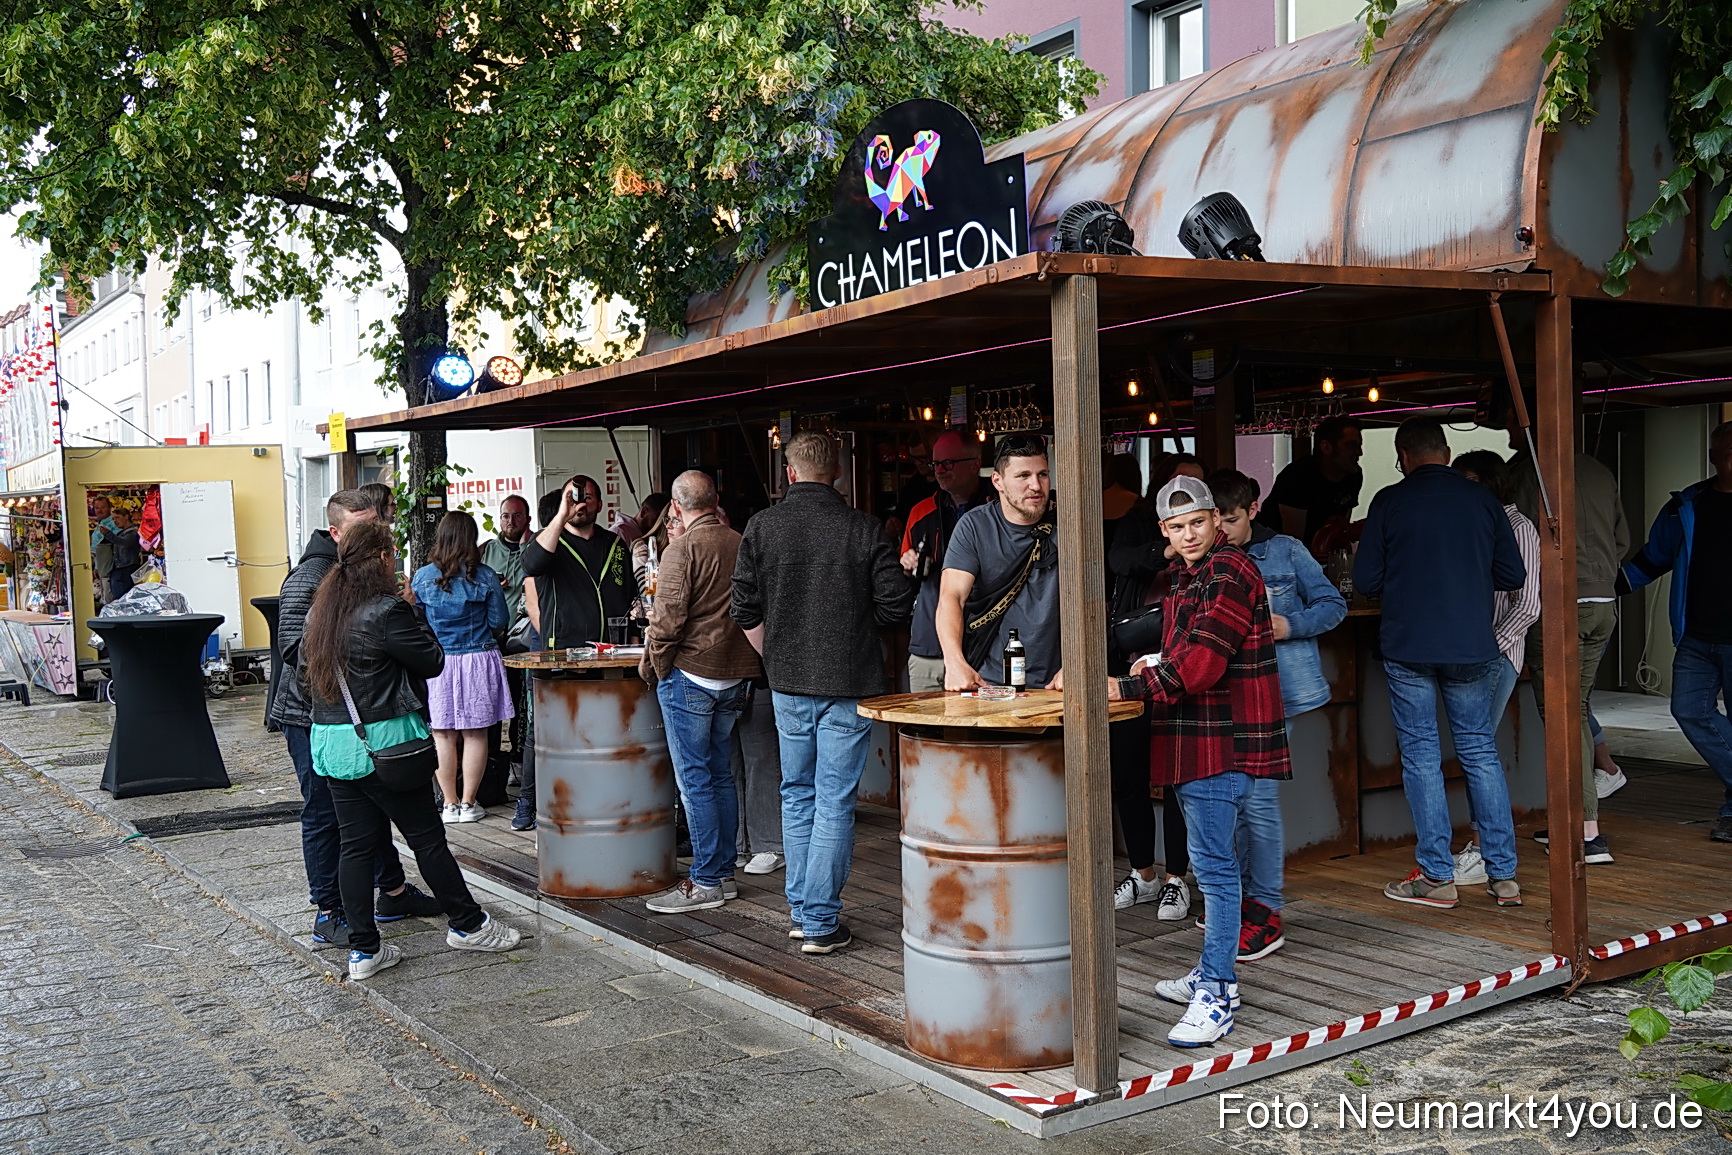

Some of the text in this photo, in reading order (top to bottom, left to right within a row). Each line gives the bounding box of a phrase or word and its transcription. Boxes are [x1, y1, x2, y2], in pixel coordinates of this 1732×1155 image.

[817, 207, 1018, 308] CHAMELEON
[425, 512, 436, 523] 39
[605, 459, 621, 529] RLEIN
